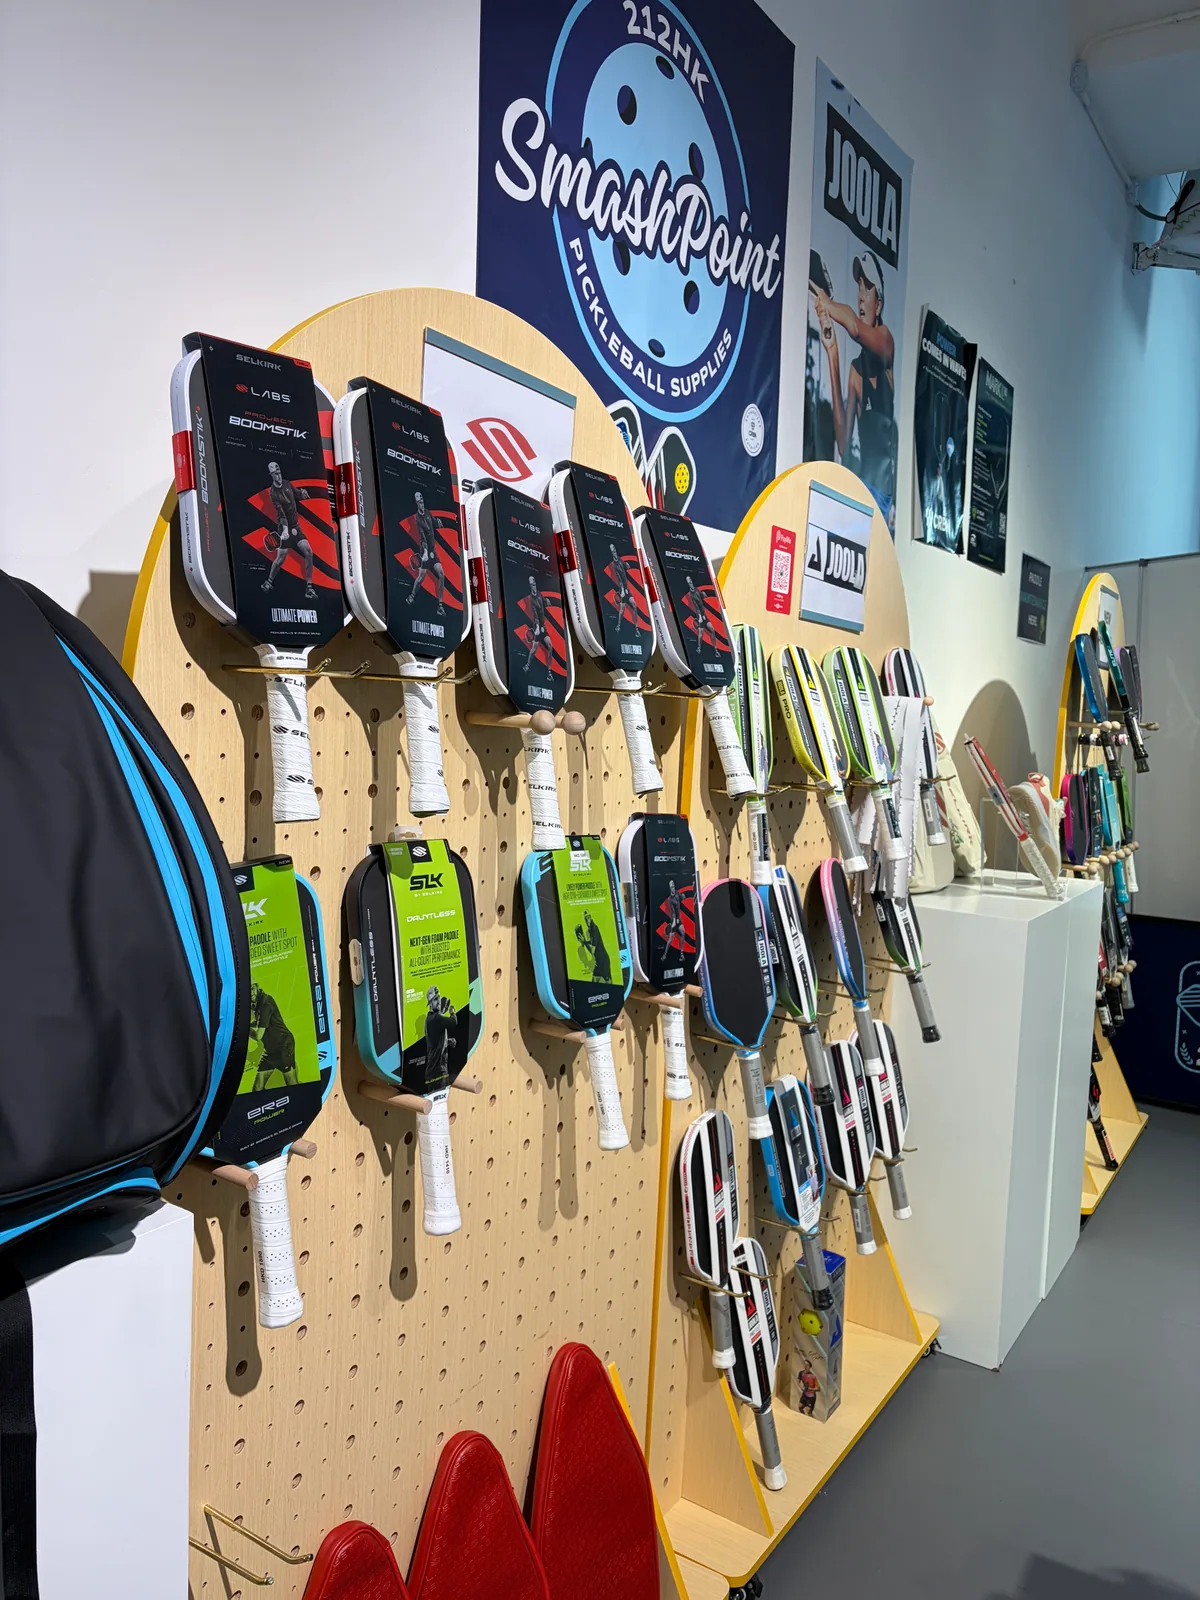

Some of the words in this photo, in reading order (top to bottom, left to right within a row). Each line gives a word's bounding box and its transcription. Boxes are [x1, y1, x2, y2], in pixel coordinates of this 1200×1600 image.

[623, 0, 709, 103] 212HK
[495, 98, 780, 298] SmashPoint
[828, 127, 897, 253] JOOLA
[569, 237, 665, 395] PICKLEBALL
[671, 328, 732, 397] SUPPLIES
[236, 354, 282, 371] SELKIRK
[250, 387, 291, 403] LABS
[391, 397, 422, 415] SELKIRK
[229, 415, 308, 439] BOOMSTIK
[245, 411, 294, 424] PROJECT
[402, 425, 430, 443] LABS
[195, 412, 209, 504] BOOMSTIK
[387, 448, 441, 476] BOOMSTIK
[518, 519, 540, 534] LABS
[589, 513, 624, 529] BOOMSTIK
[184, 511, 192, 564] BOOMSTIK
[507, 539, 550, 562] BOOMSTIK
[665, 550, 700, 562] BOOMSTIK
[826, 541, 865, 590] JOOLA
[271, 608, 297, 623] ULTIMATE
[297, 609, 318, 624] POWER
[430, 623, 445, 638] POWER
[782, 699, 791, 719] PRO
[410, 873, 444, 891] SLK
[406, 909, 456, 923] DAUNTLESS
[249, 931, 271, 946] PADDLE
[271, 928, 287, 940] WITH
[262, 941, 282, 955] SWEET
[282, 936, 298, 949] SPOT
[409, 936, 430, 948] NEXT-GEN
[430, 931, 444, 943] FOAM
[443, 929, 459, 941] PADDLE
[420, 944, 431, 955] WITH
[431, 941, 450, 953] BOOSTED
[760, 940, 768, 967] JOOLA
[368, 931, 379, 1001] DAUNTLESS
[409, 954, 431, 968] ALL-COURT
[431, 949, 460, 964] PERFORMANCE
[763, 1289, 772, 1315] JOOLA
